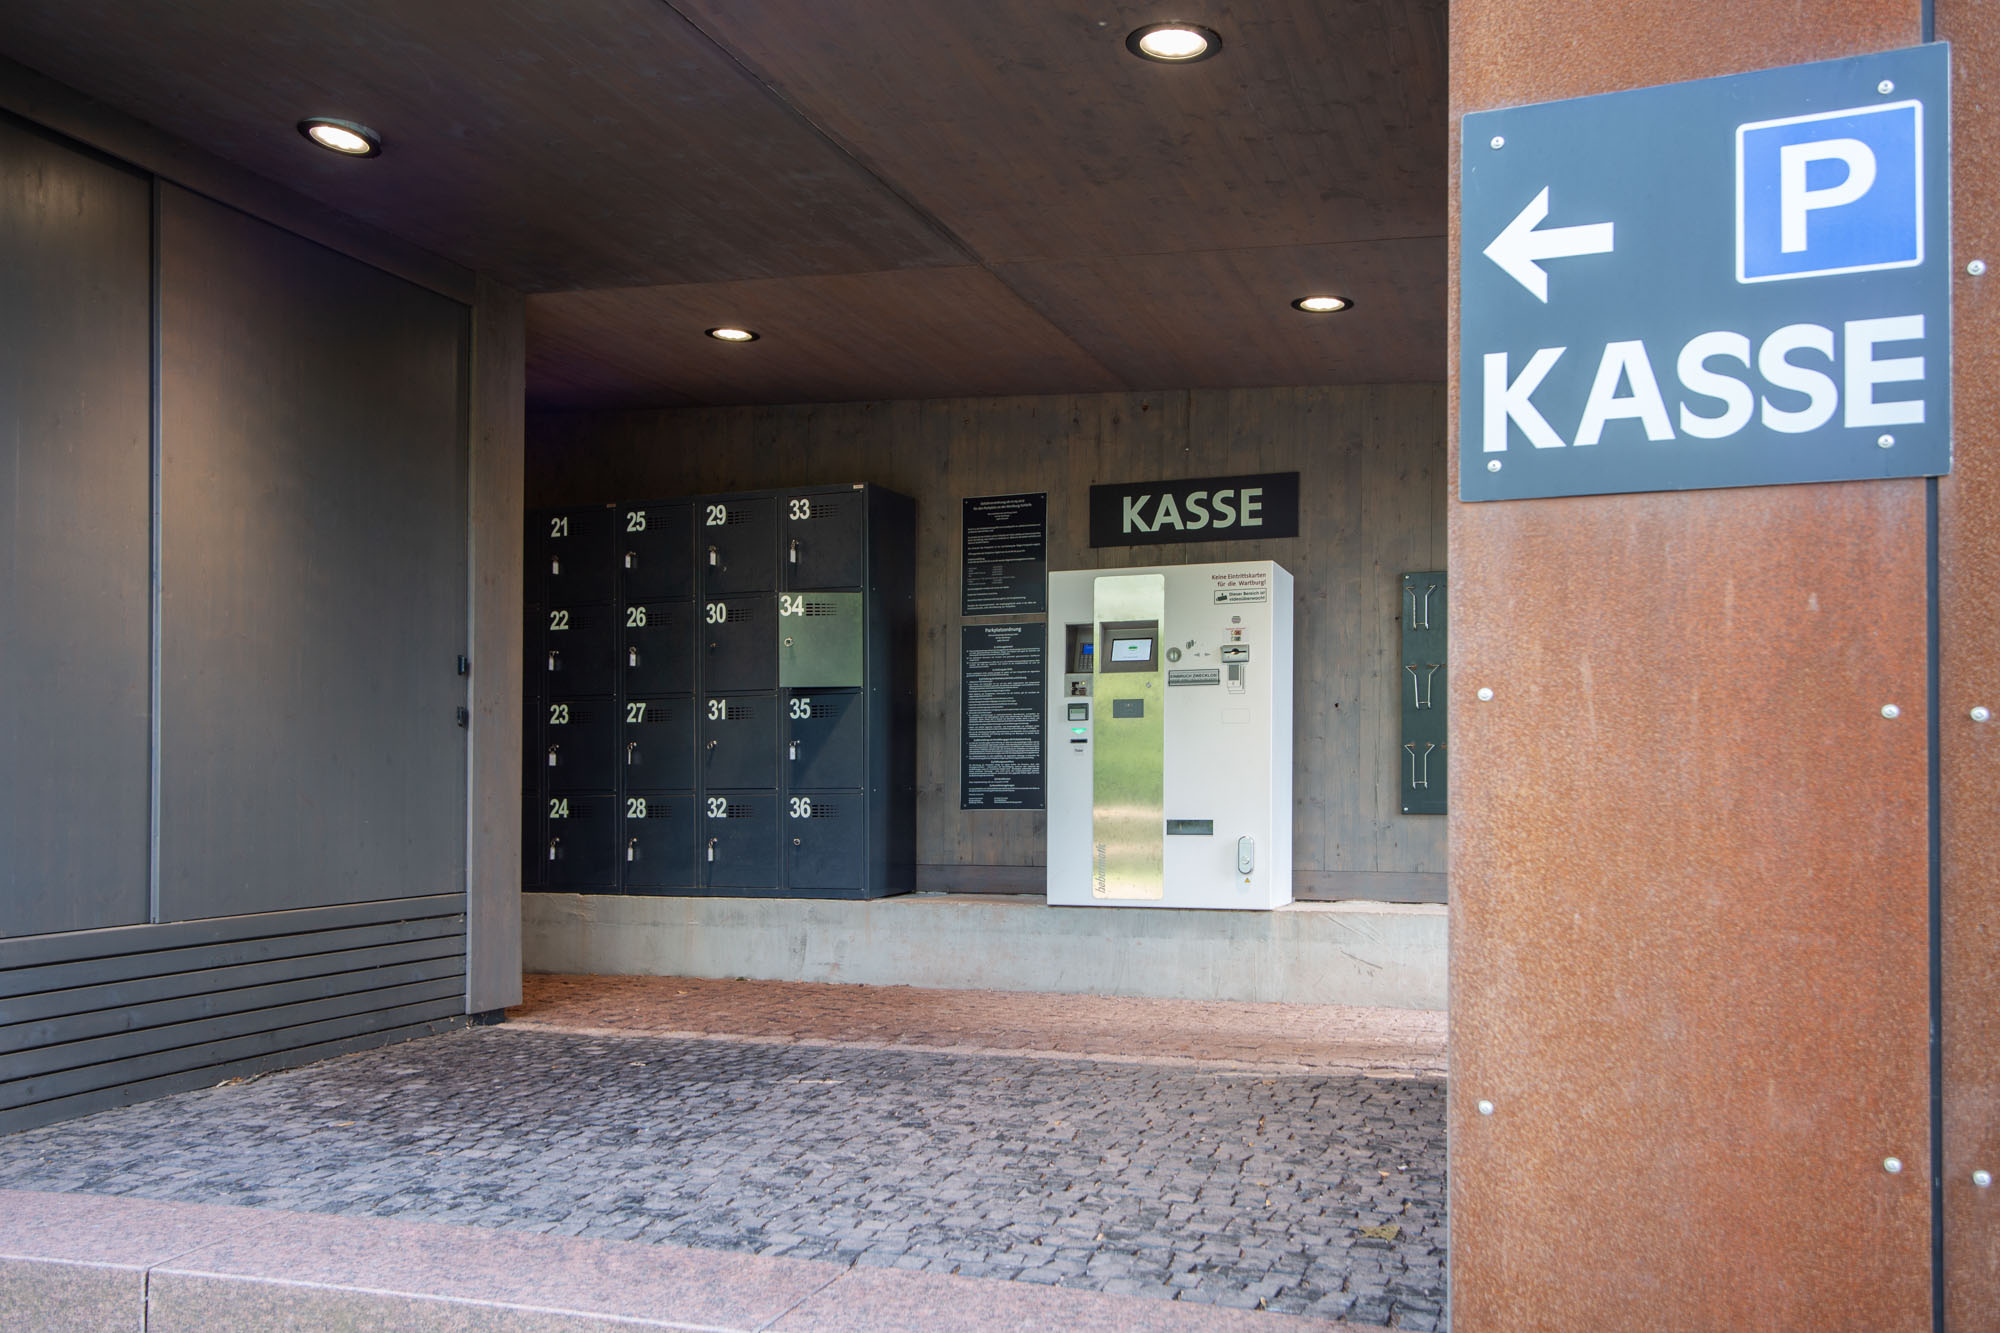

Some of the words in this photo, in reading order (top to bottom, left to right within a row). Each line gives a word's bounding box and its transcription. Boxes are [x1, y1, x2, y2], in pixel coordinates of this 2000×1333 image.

[1780, 138, 1877, 254] P
[1483, 314, 1925, 453] KASSE
[706, 504, 727, 526] 29
[789, 498, 810, 521] 33
[1123, 487, 1263, 533] KASSE
[551, 516, 568, 538] 21
[626, 511, 646, 532] 25
[626, 606, 647, 627] 26
[706, 602, 727, 624] 30
[780, 595, 805, 617] 34
[550, 610, 569, 631] 22
[550, 704, 569, 725] 23
[626, 702, 647, 723] 27
[708, 699, 726, 721] 31
[789, 697, 811, 720] 35
[550, 798, 569, 819] 24
[626, 798, 647, 819] 28
[707, 797, 727, 818] 32
[790, 797, 811, 819] 36
